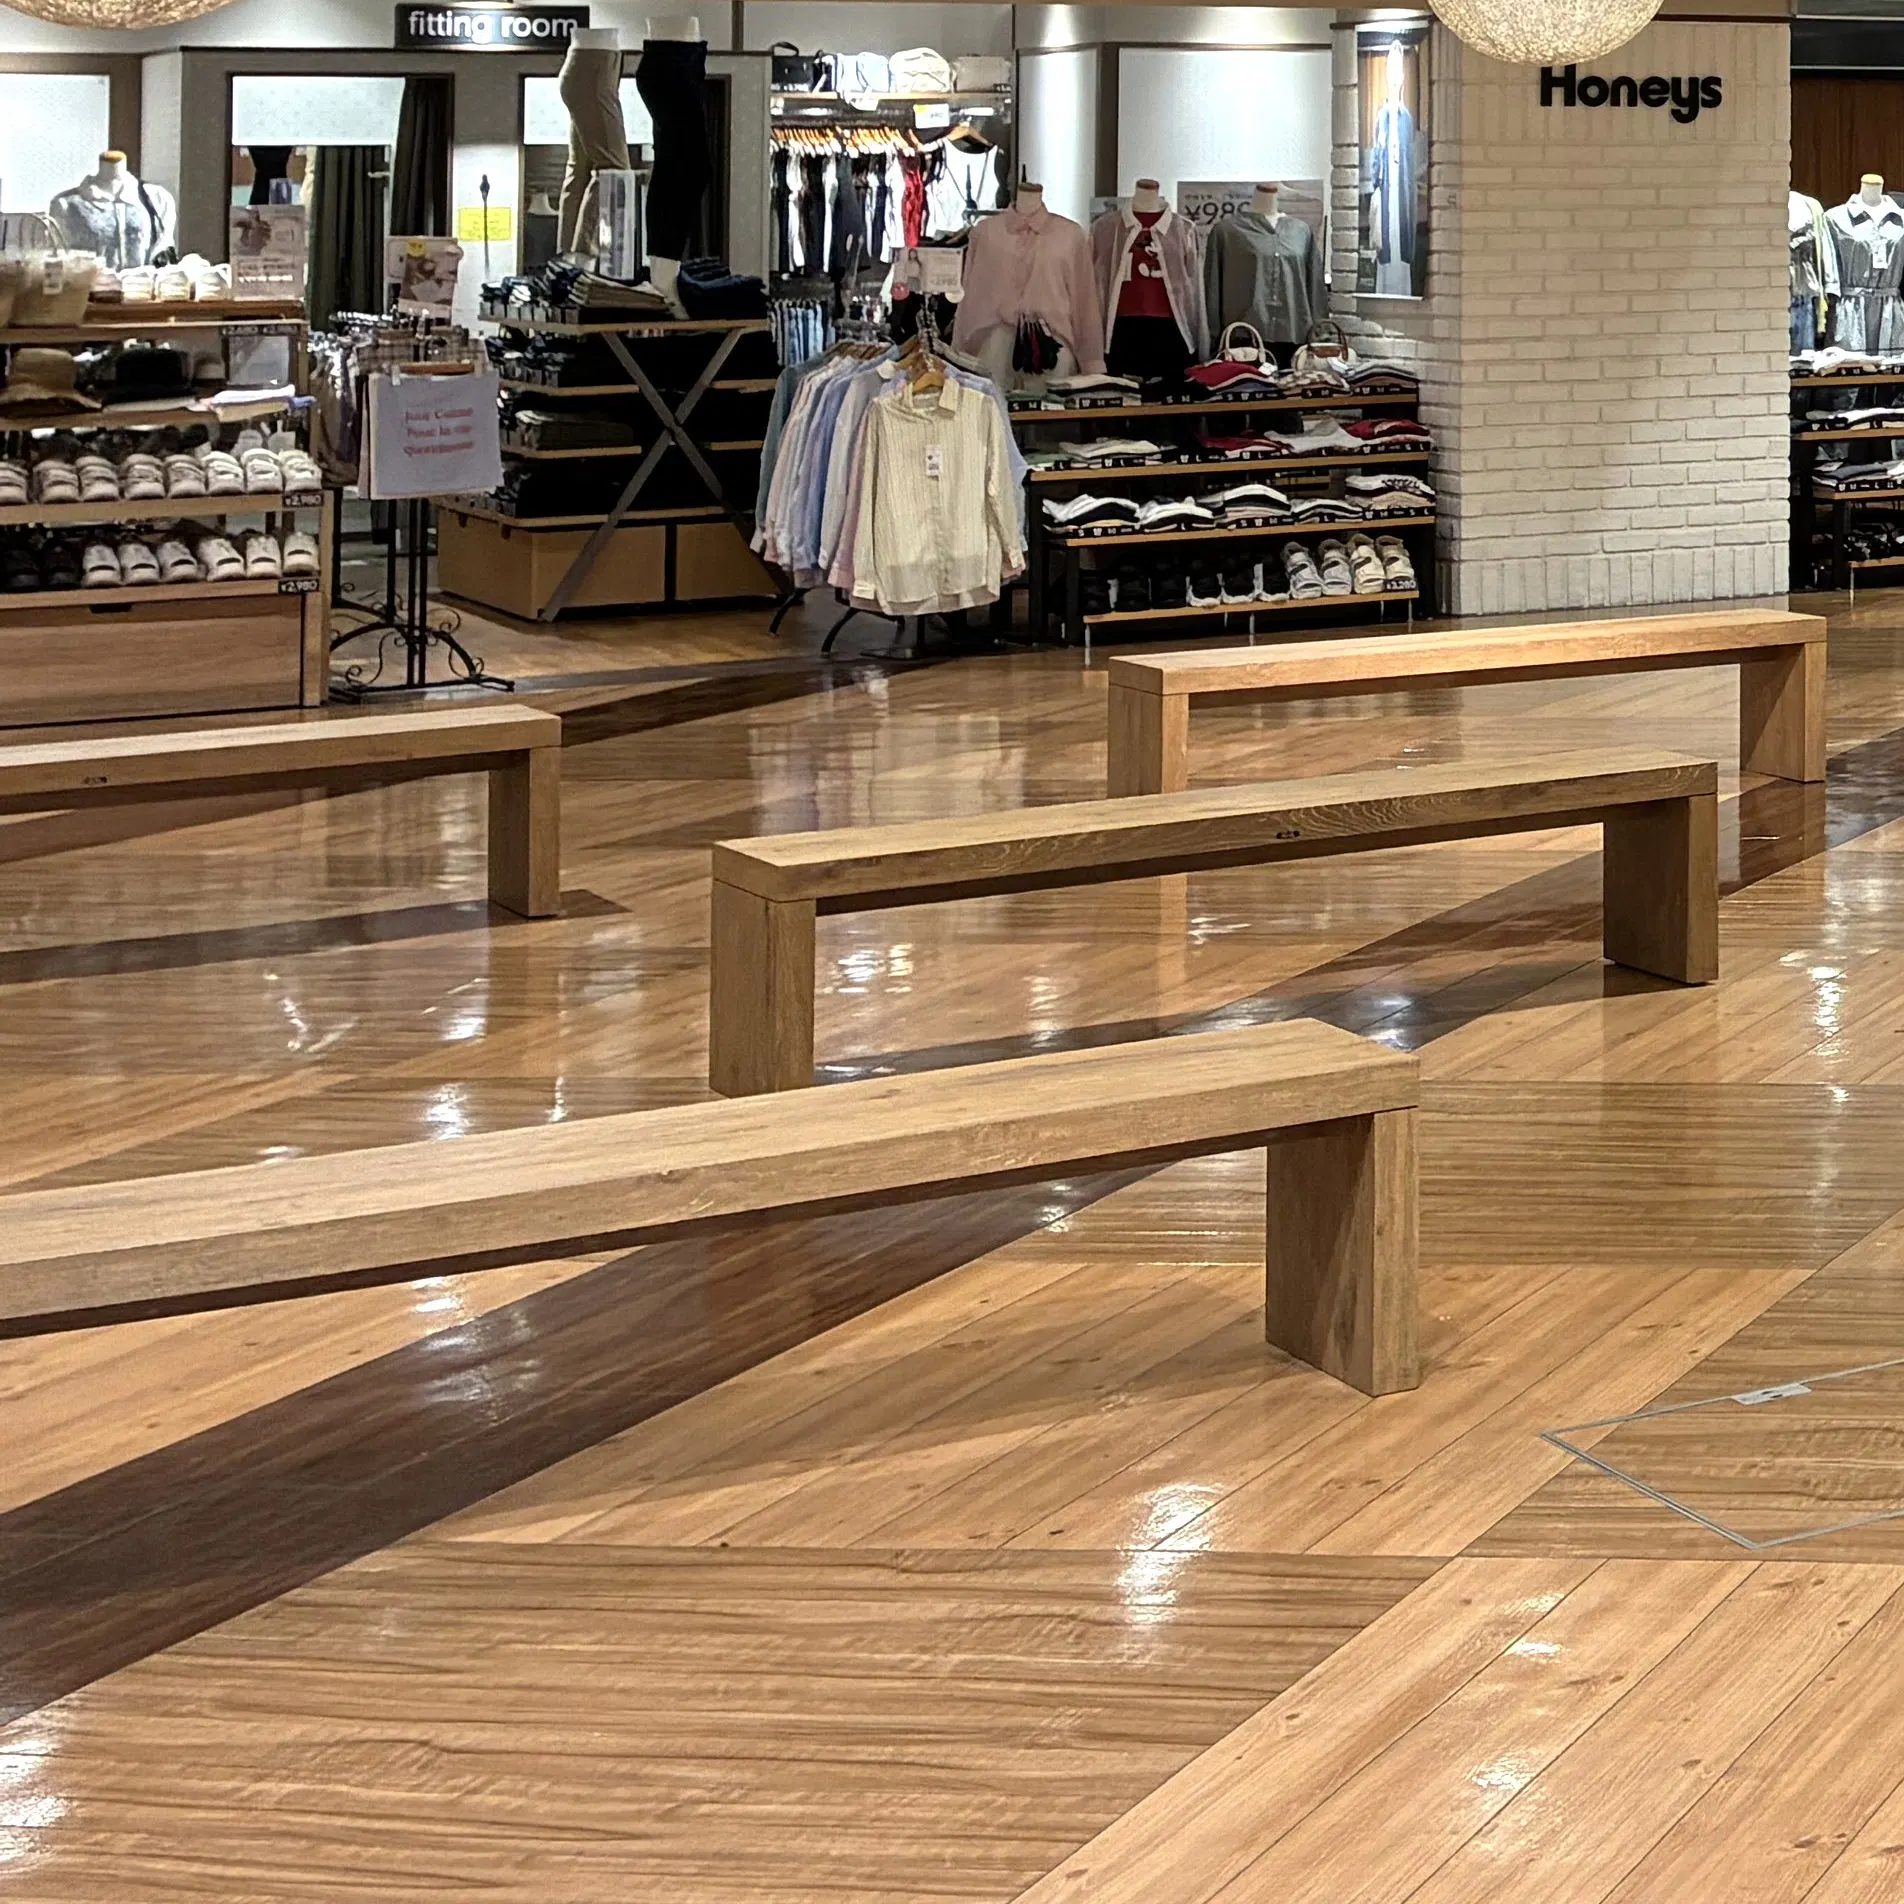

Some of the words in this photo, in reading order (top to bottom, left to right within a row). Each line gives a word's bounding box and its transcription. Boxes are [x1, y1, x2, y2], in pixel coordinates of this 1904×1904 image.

[408, 10, 493, 44] fitting
[501, 16, 578, 38] room
[1540, 64, 1722, 124] Honeys
